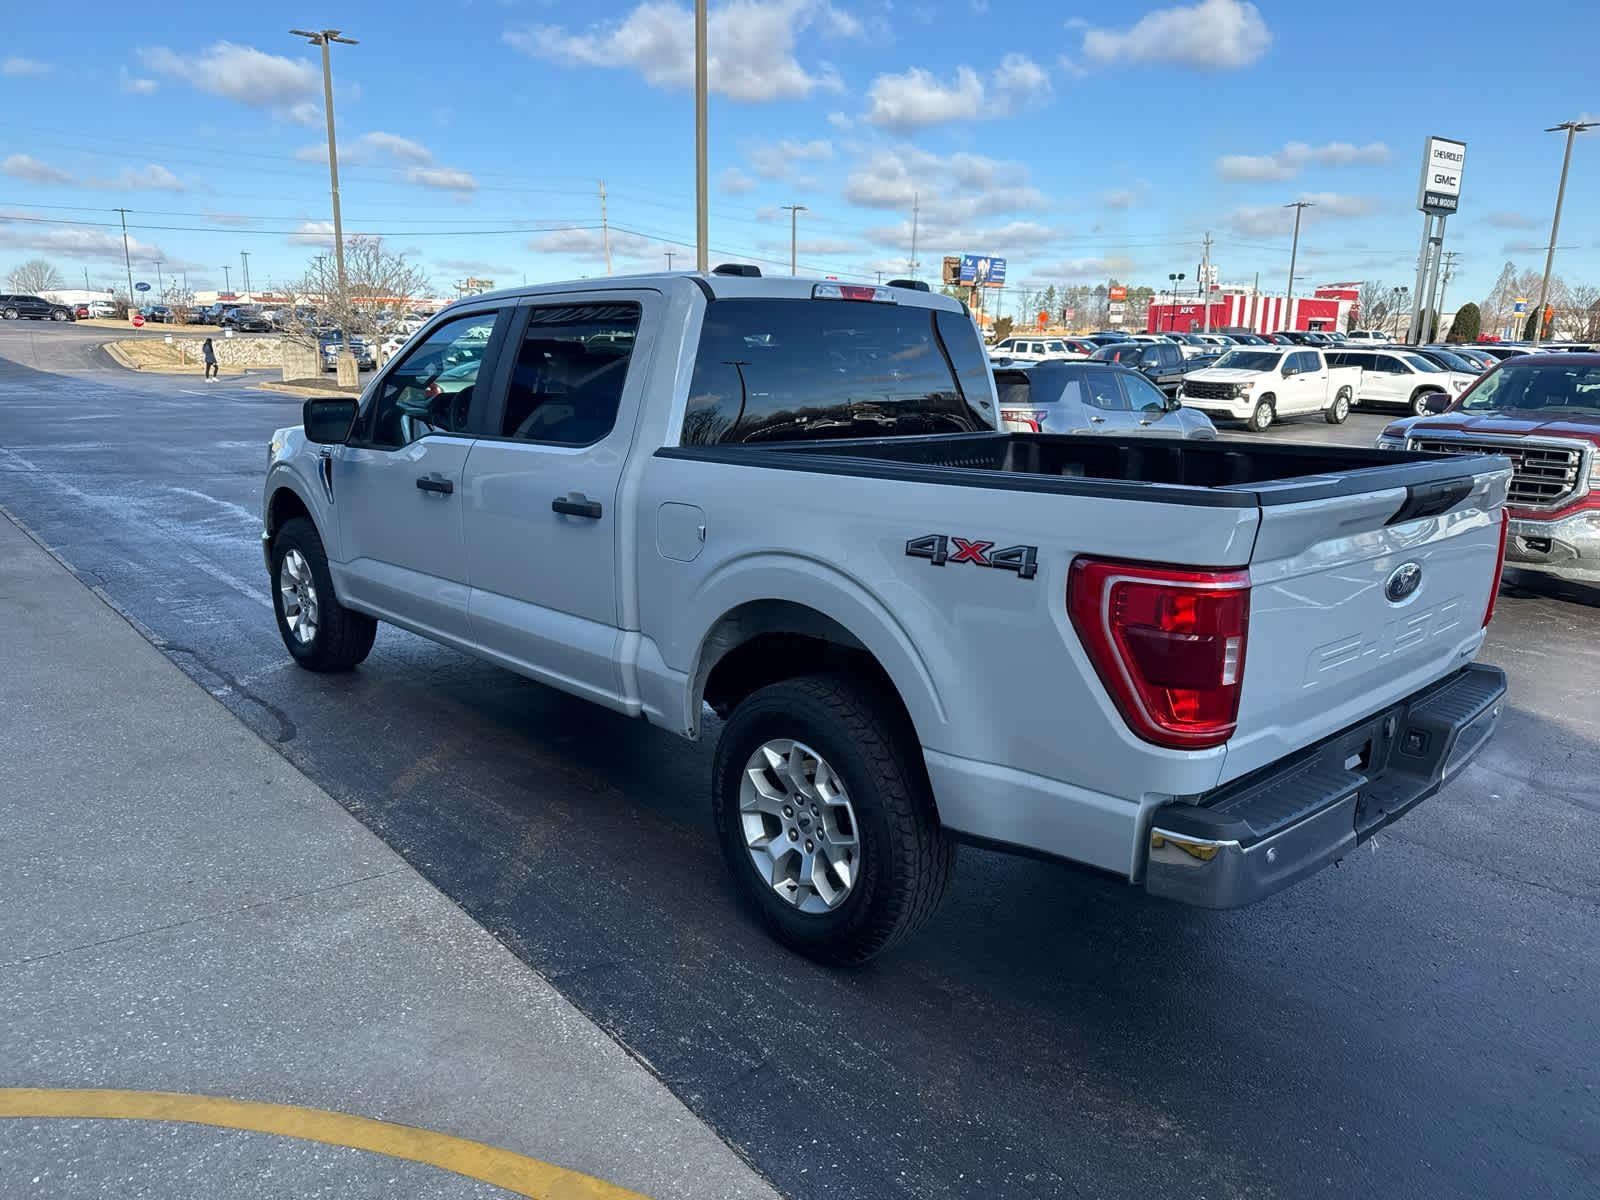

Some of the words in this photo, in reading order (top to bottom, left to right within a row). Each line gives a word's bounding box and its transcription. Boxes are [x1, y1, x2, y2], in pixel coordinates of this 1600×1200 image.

[1433, 149, 1463, 162] CHEVROLET
[1434, 174, 1457, 186] GMC
[1179, 306, 1196, 314] KFC
